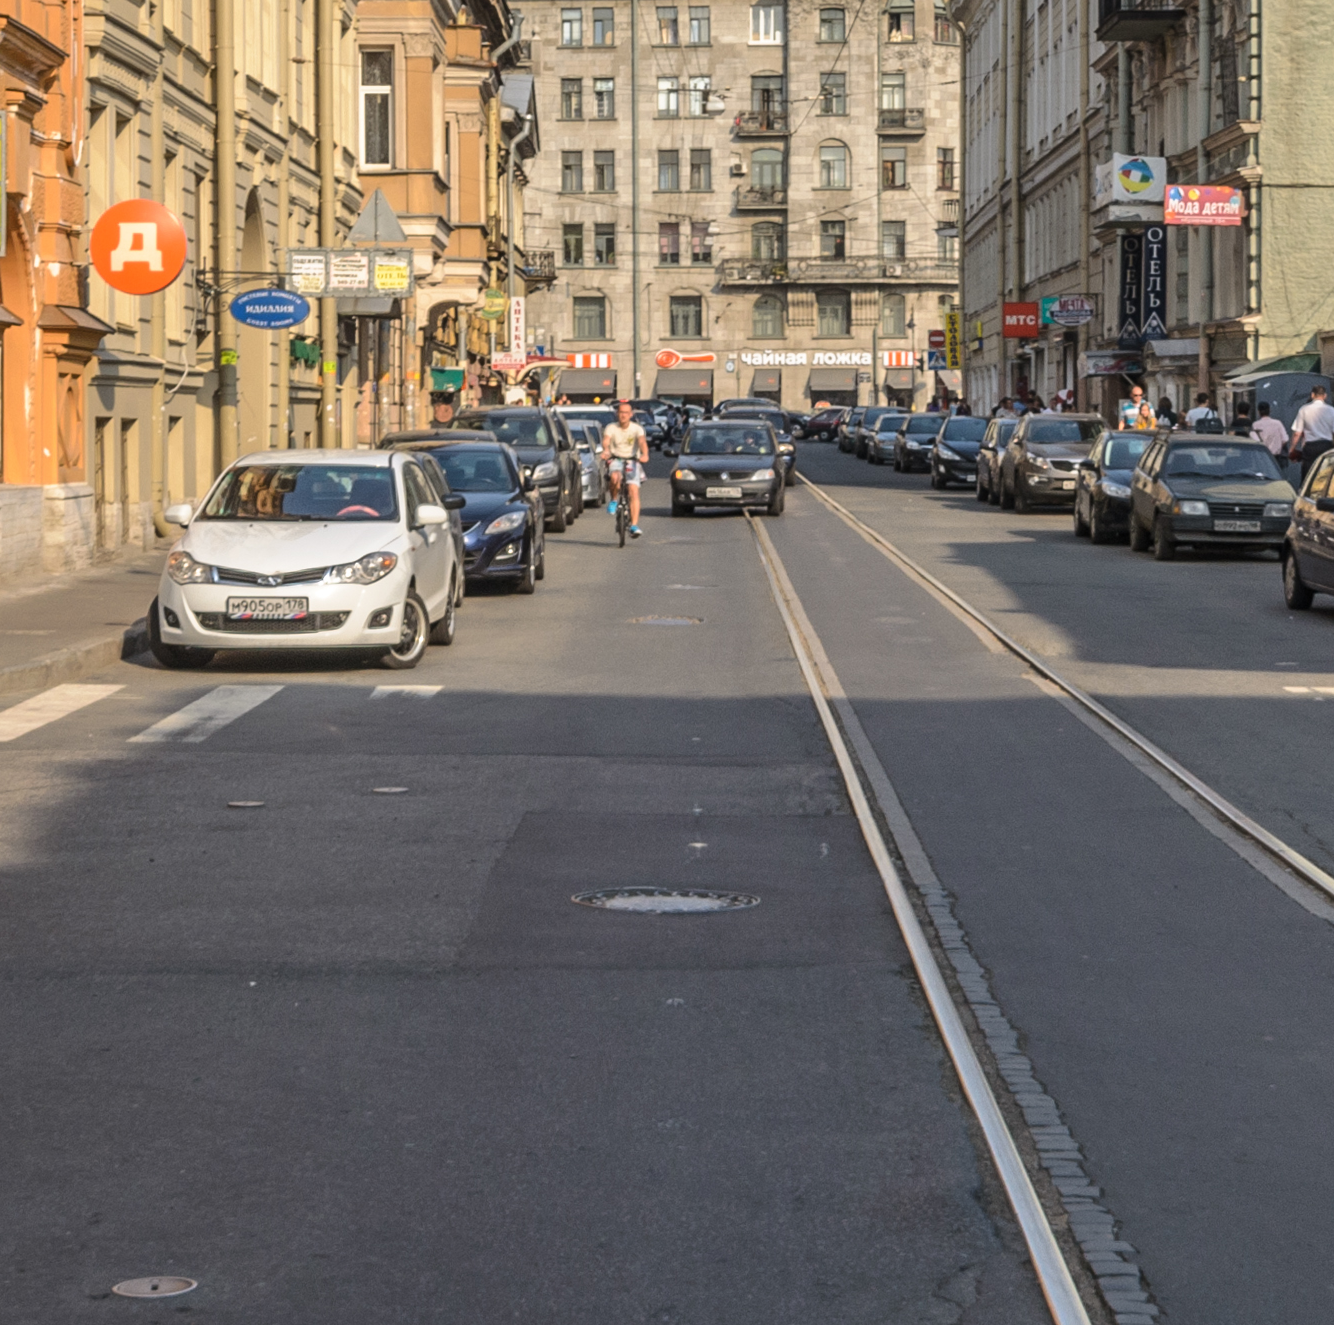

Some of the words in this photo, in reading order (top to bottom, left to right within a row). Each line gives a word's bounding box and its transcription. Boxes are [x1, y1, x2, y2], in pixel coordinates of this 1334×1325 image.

[1167, 199, 1200, 215] Мода
[1202, 201, 1240, 216] детям
[110, 222, 164, 272] Д
[1146, 227, 1164, 308] ОТЕЛЬ
[1123, 237, 1139, 315] ОТЕЛЬ
[513, 299, 522, 350] АПТЕКА
[1005, 314, 1036, 326] МТС
[740, 349, 807, 366] чайная
[812, 351, 873, 366] ложка
